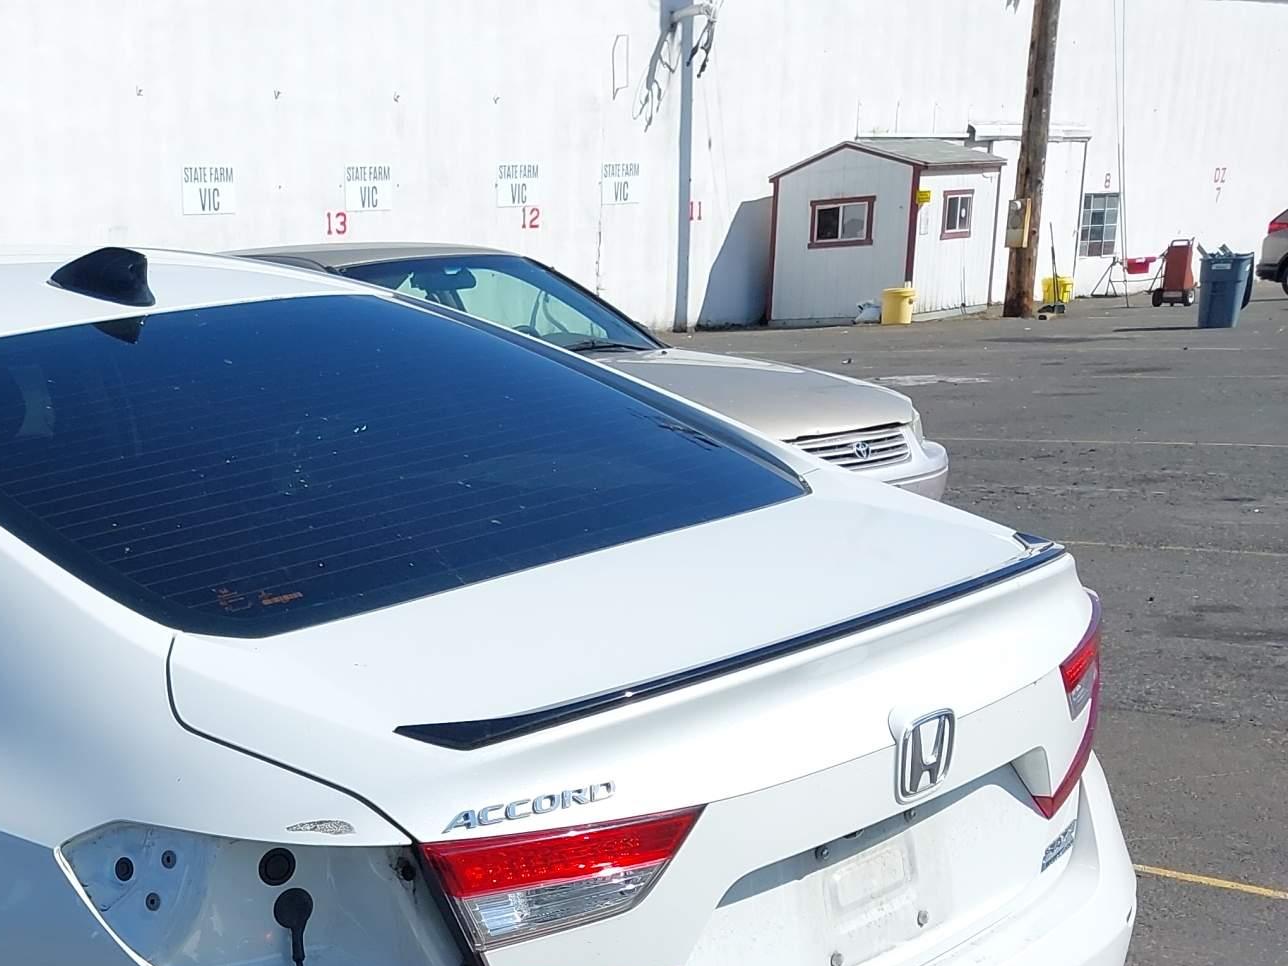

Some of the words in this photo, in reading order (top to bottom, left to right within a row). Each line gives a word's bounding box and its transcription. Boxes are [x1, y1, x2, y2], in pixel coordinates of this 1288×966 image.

[184, 166, 208, 183] STATE
[209, 166, 234, 182] FARM
[347, 166, 367, 182] STATE
[368, 166, 391, 181] FARM
[499, 164, 518, 180] STATE
[519, 163, 539, 179] FARM
[604, 163, 621, 179] STATE
[622, 162, 640, 178] FARM
[1104, 173, 1111, 188] 8
[198, 187, 220, 212] VIC
[359, 185, 378, 209] VIC
[510, 182, 527, 205] VIC
[614, 180, 629, 202] VIC
[520, 206, 540, 229] 12
[689, 201, 702, 220] 11
[326, 211, 348, 235] 13
[443, 781, 616, 834] ACCORD
